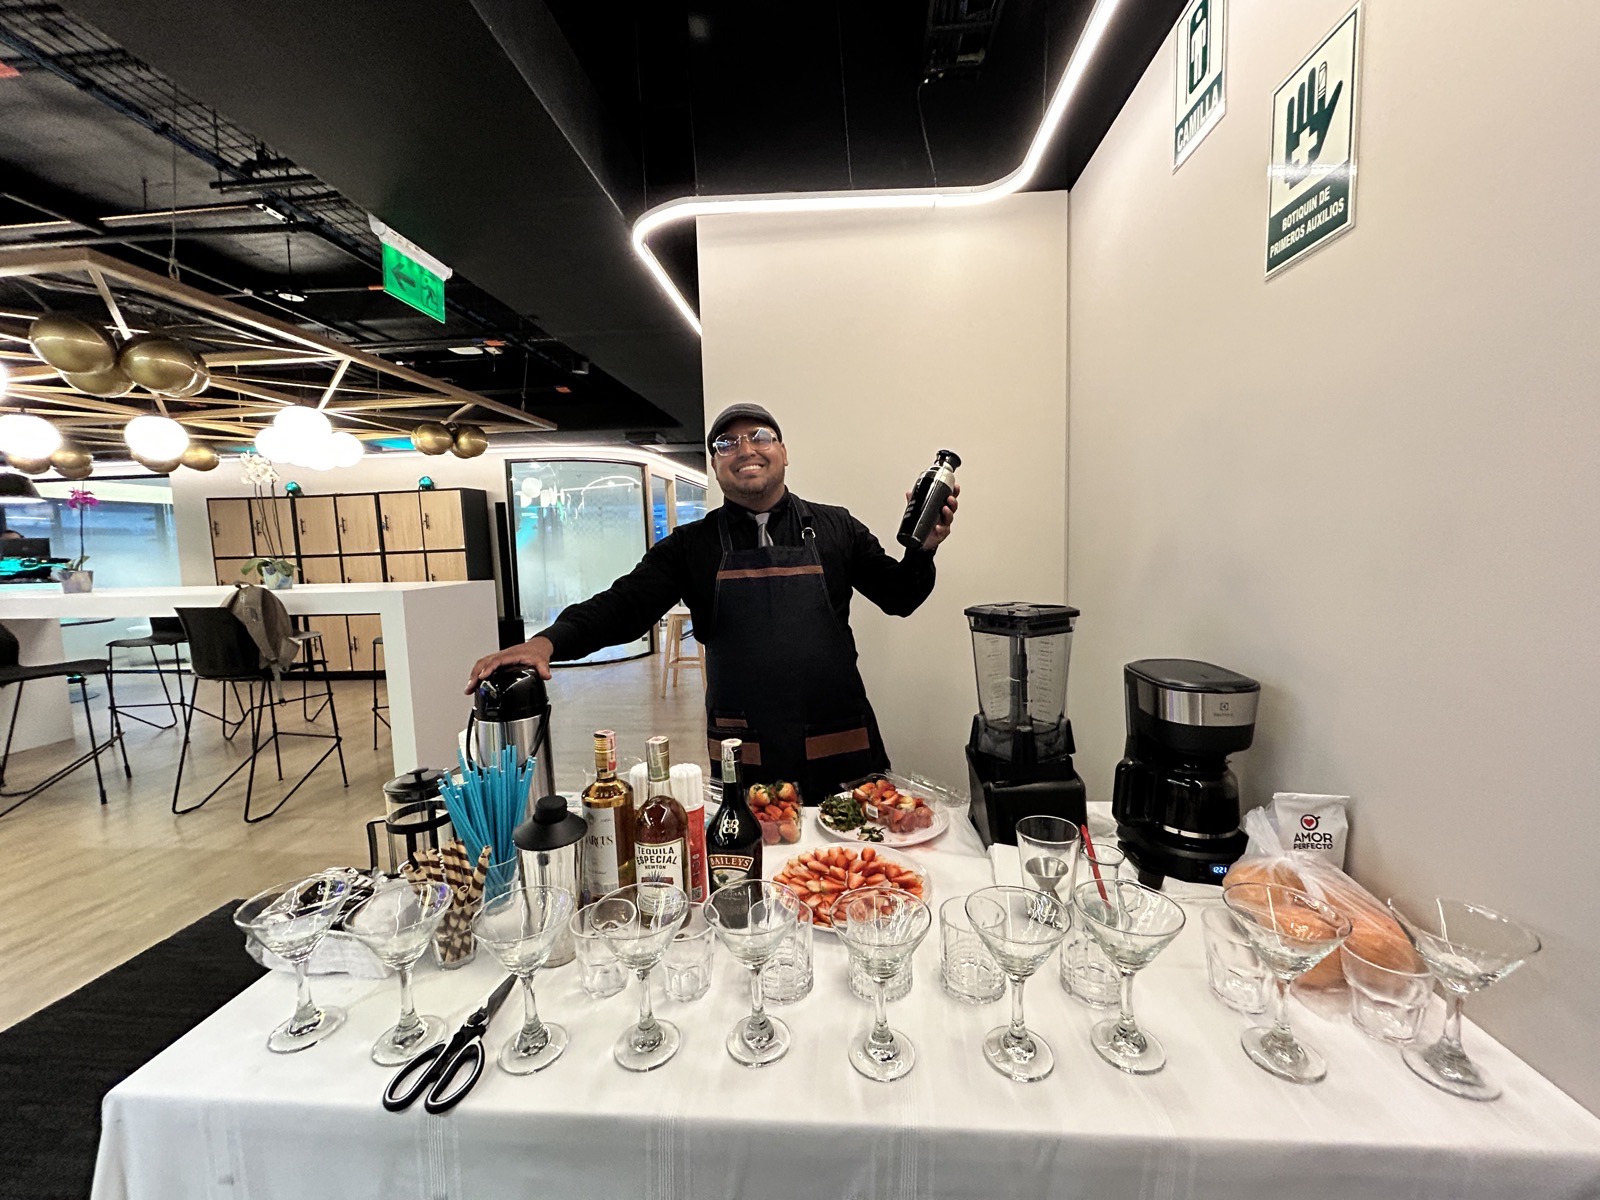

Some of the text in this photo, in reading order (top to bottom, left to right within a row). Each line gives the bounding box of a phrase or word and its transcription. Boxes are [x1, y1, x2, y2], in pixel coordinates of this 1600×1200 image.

[1177, 83, 1220, 153] CAMILLA
[1282, 185, 1331, 232] BOTIQUIN DE
[1269, 197, 1345, 259] PRIMEROS AUXILIOS
[1294, 832, 1333, 843] AMOR
[637, 846, 675, 855] TEQUILA
[636, 855, 678, 866] ESPECIAL
[710, 857, 750, 867] BAILEYS
